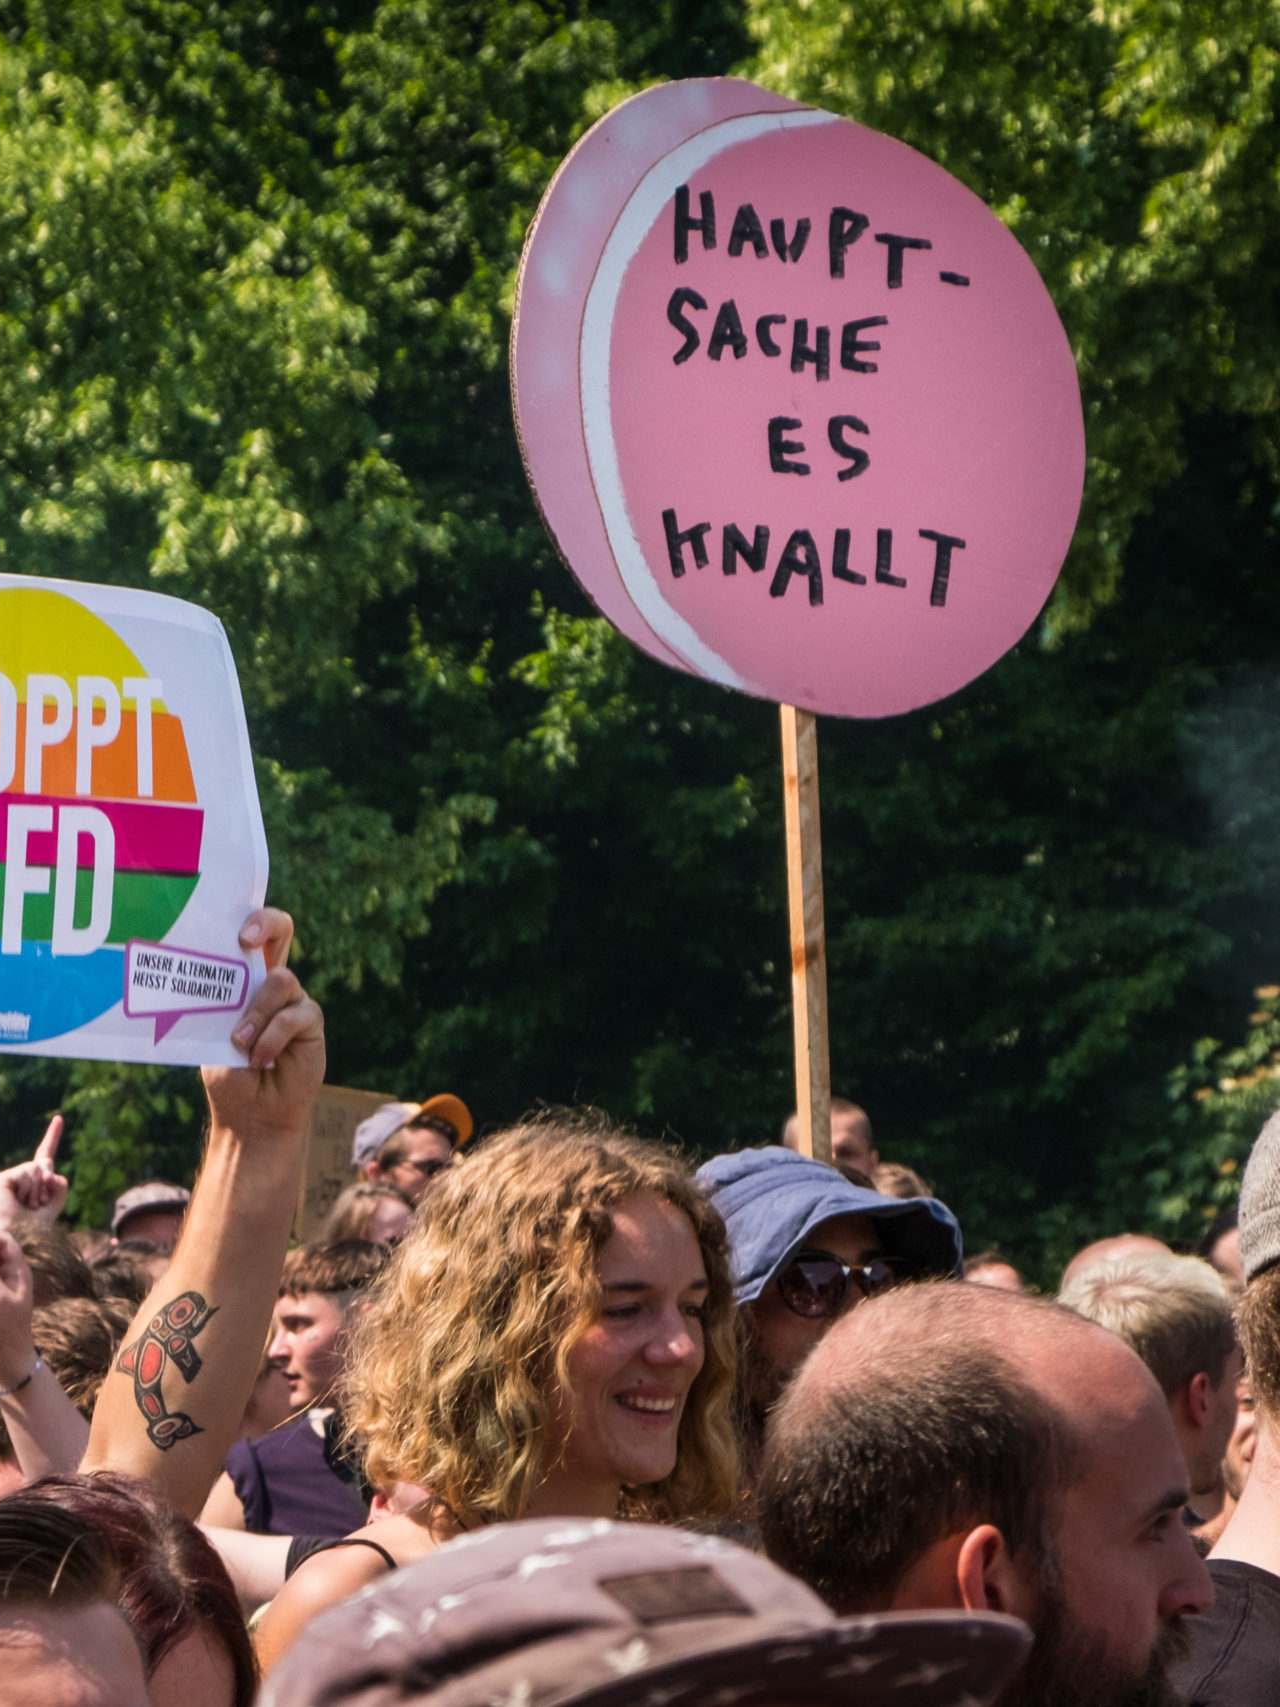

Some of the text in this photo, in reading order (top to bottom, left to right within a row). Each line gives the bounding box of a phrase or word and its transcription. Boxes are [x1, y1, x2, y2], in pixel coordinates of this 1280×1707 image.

[674, 184, 971, 289] HAUPT-
[666, 286, 889, 382] SACHE
[767, 415, 871, 482] ES
[661, 508, 967, 607] KNALLT
[132, 970, 168, 991] HEISST
[136, 951, 237, 985] UNSERE ALTERNATIVE
